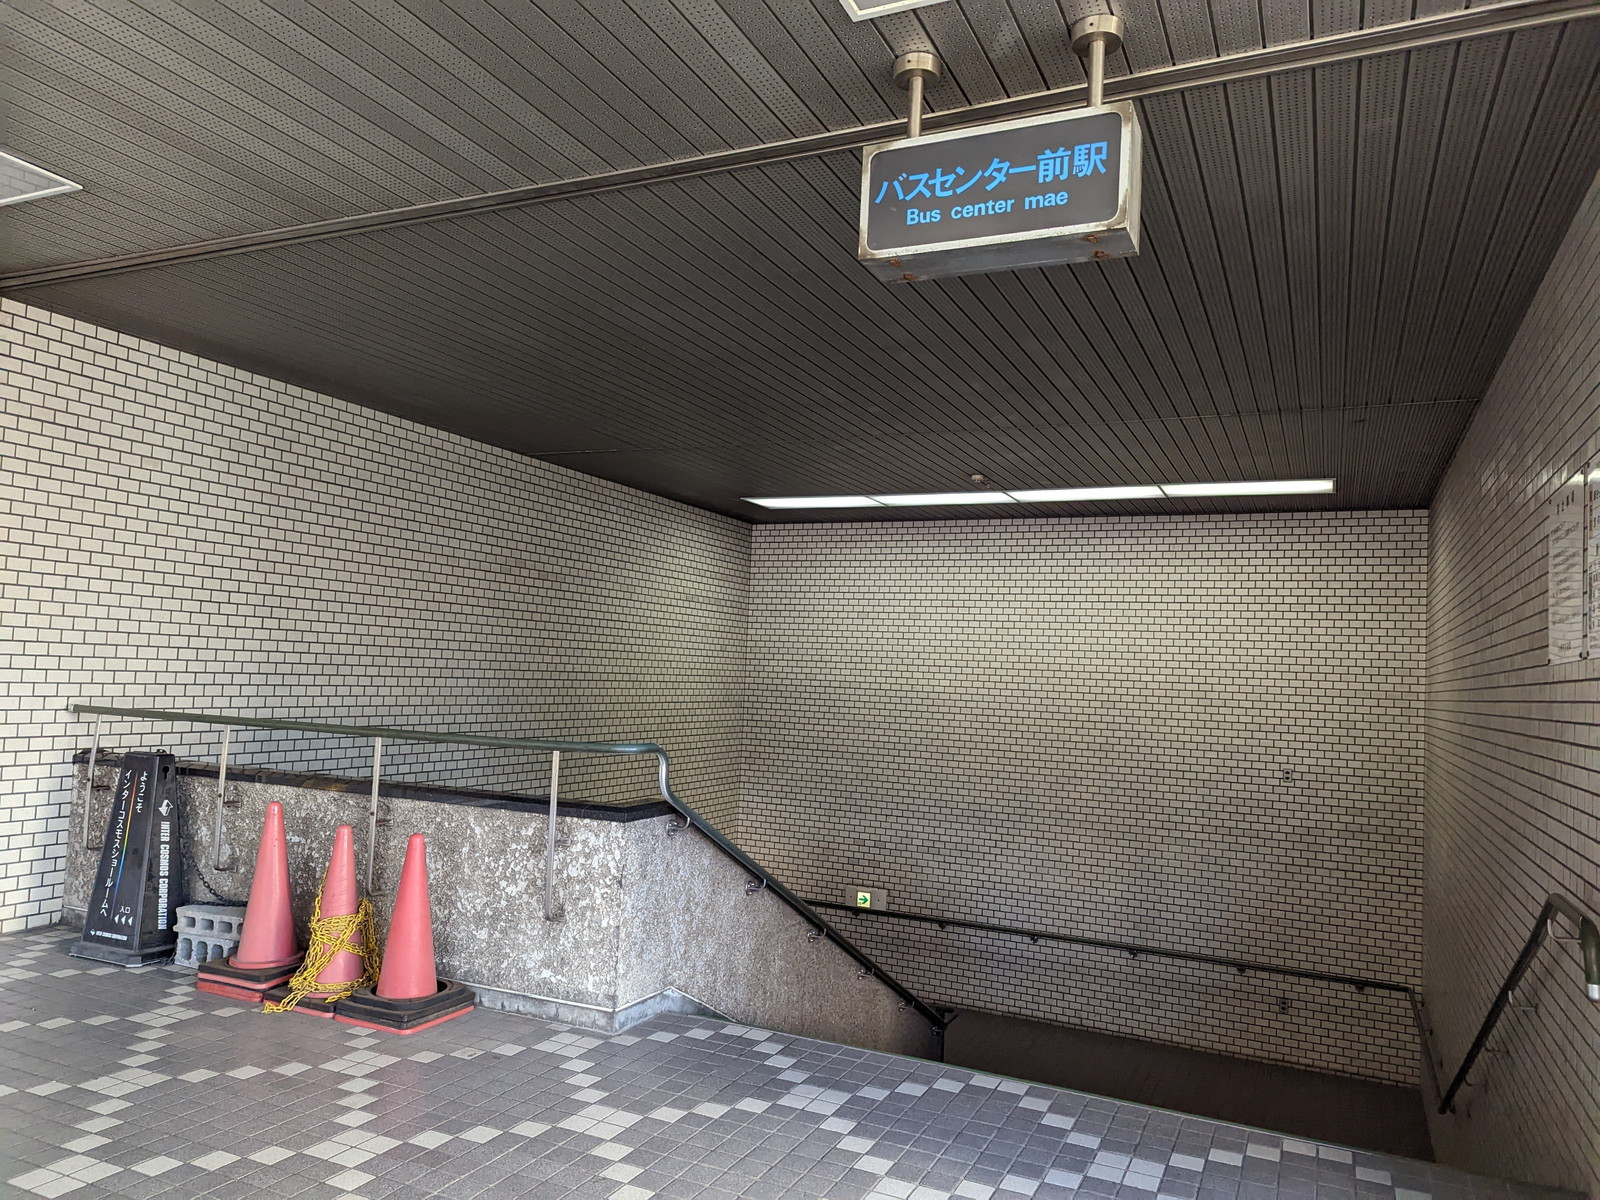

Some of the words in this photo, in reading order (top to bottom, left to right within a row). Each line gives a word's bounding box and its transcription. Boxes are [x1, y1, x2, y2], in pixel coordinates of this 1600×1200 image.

[874, 141, 1108, 205] バスセンター前駅
[906, 207, 941, 226] Bus
[951, 197, 1014, 220] center
[1024, 189, 1069, 211] mae
[135, 770, 148, 814] ようこそ
[99, 769, 133, 917] インターコスモスショールームへ
[160, 821, 170, 842] INTER
[159, 844, 170, 877] COSMOS
[119, 905, 131, 914] 入口
[157, 878, 169, 930] CORPORATION
